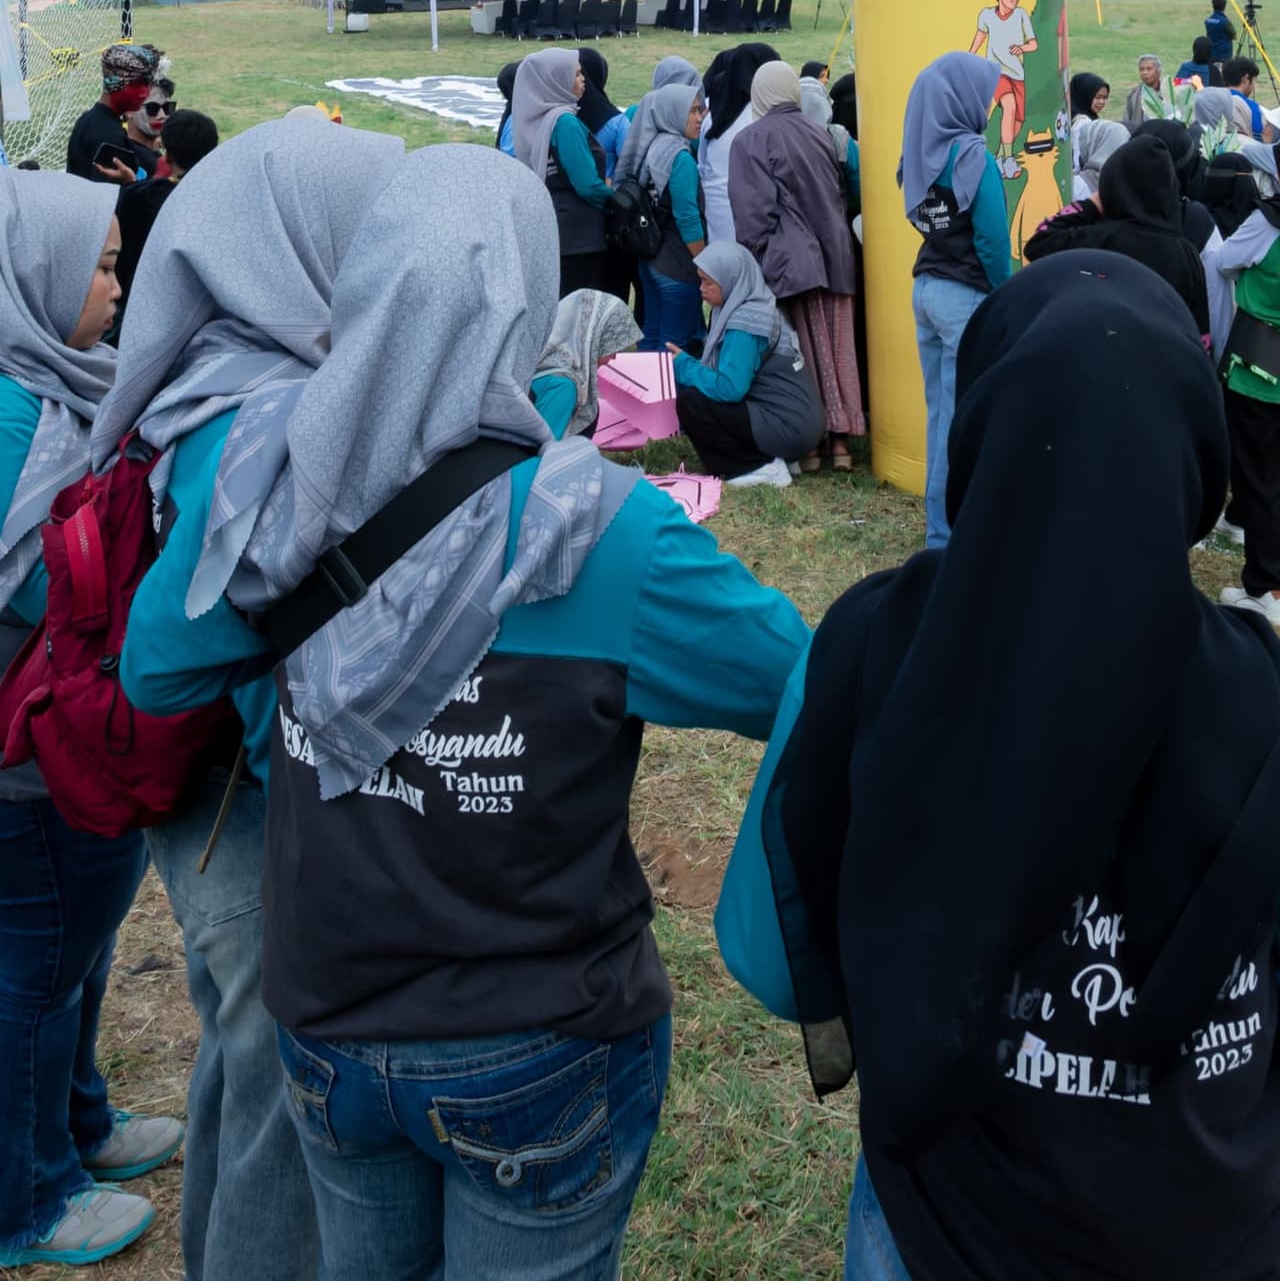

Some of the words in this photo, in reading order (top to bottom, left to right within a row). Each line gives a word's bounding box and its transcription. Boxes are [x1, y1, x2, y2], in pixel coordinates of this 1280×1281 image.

[279, 704, 317, 768] ESA
[405, 714, 526, 768] osyandu
[439, 771, 525, 793] Tahun
[457, 795, 514, 814] 2023
[1180, 1011, 1262, 1057] ahun
[1194, 1042, 1254, 1081] 2023
